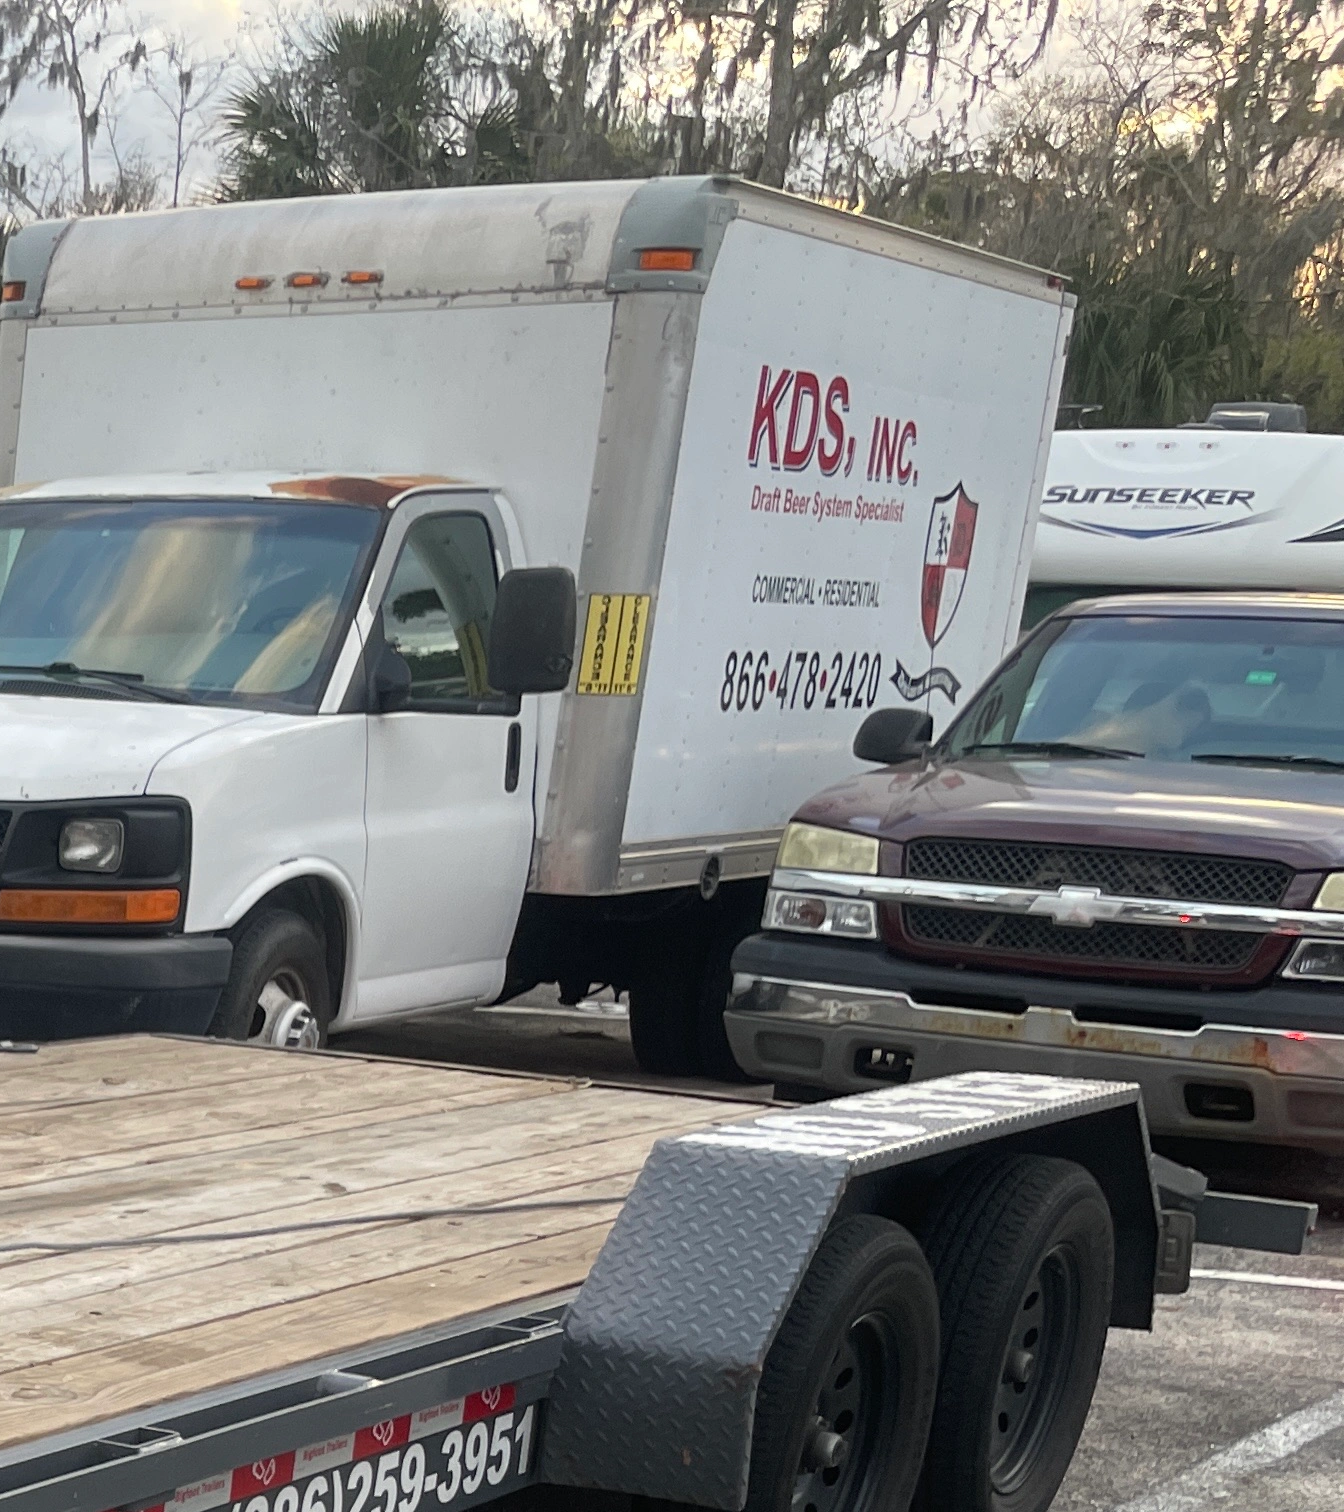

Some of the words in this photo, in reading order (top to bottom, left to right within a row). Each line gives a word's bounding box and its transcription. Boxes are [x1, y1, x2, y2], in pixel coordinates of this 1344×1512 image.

[748, 365, 856, 477] KDS,
[867, 416, 919, 487] INC.
[751, 485, 781, 513] Draft
[783, 488, 811, 515] Beer
[812, 491, 853, 523] System
[854, 495, 905, 526] Specialist
[1043, 485, 1255, 512] SUNSEEKER
[752, 574, 815, 606] COMMERCIAL
[824, 579, 879, 608] RESIDENTIAL
